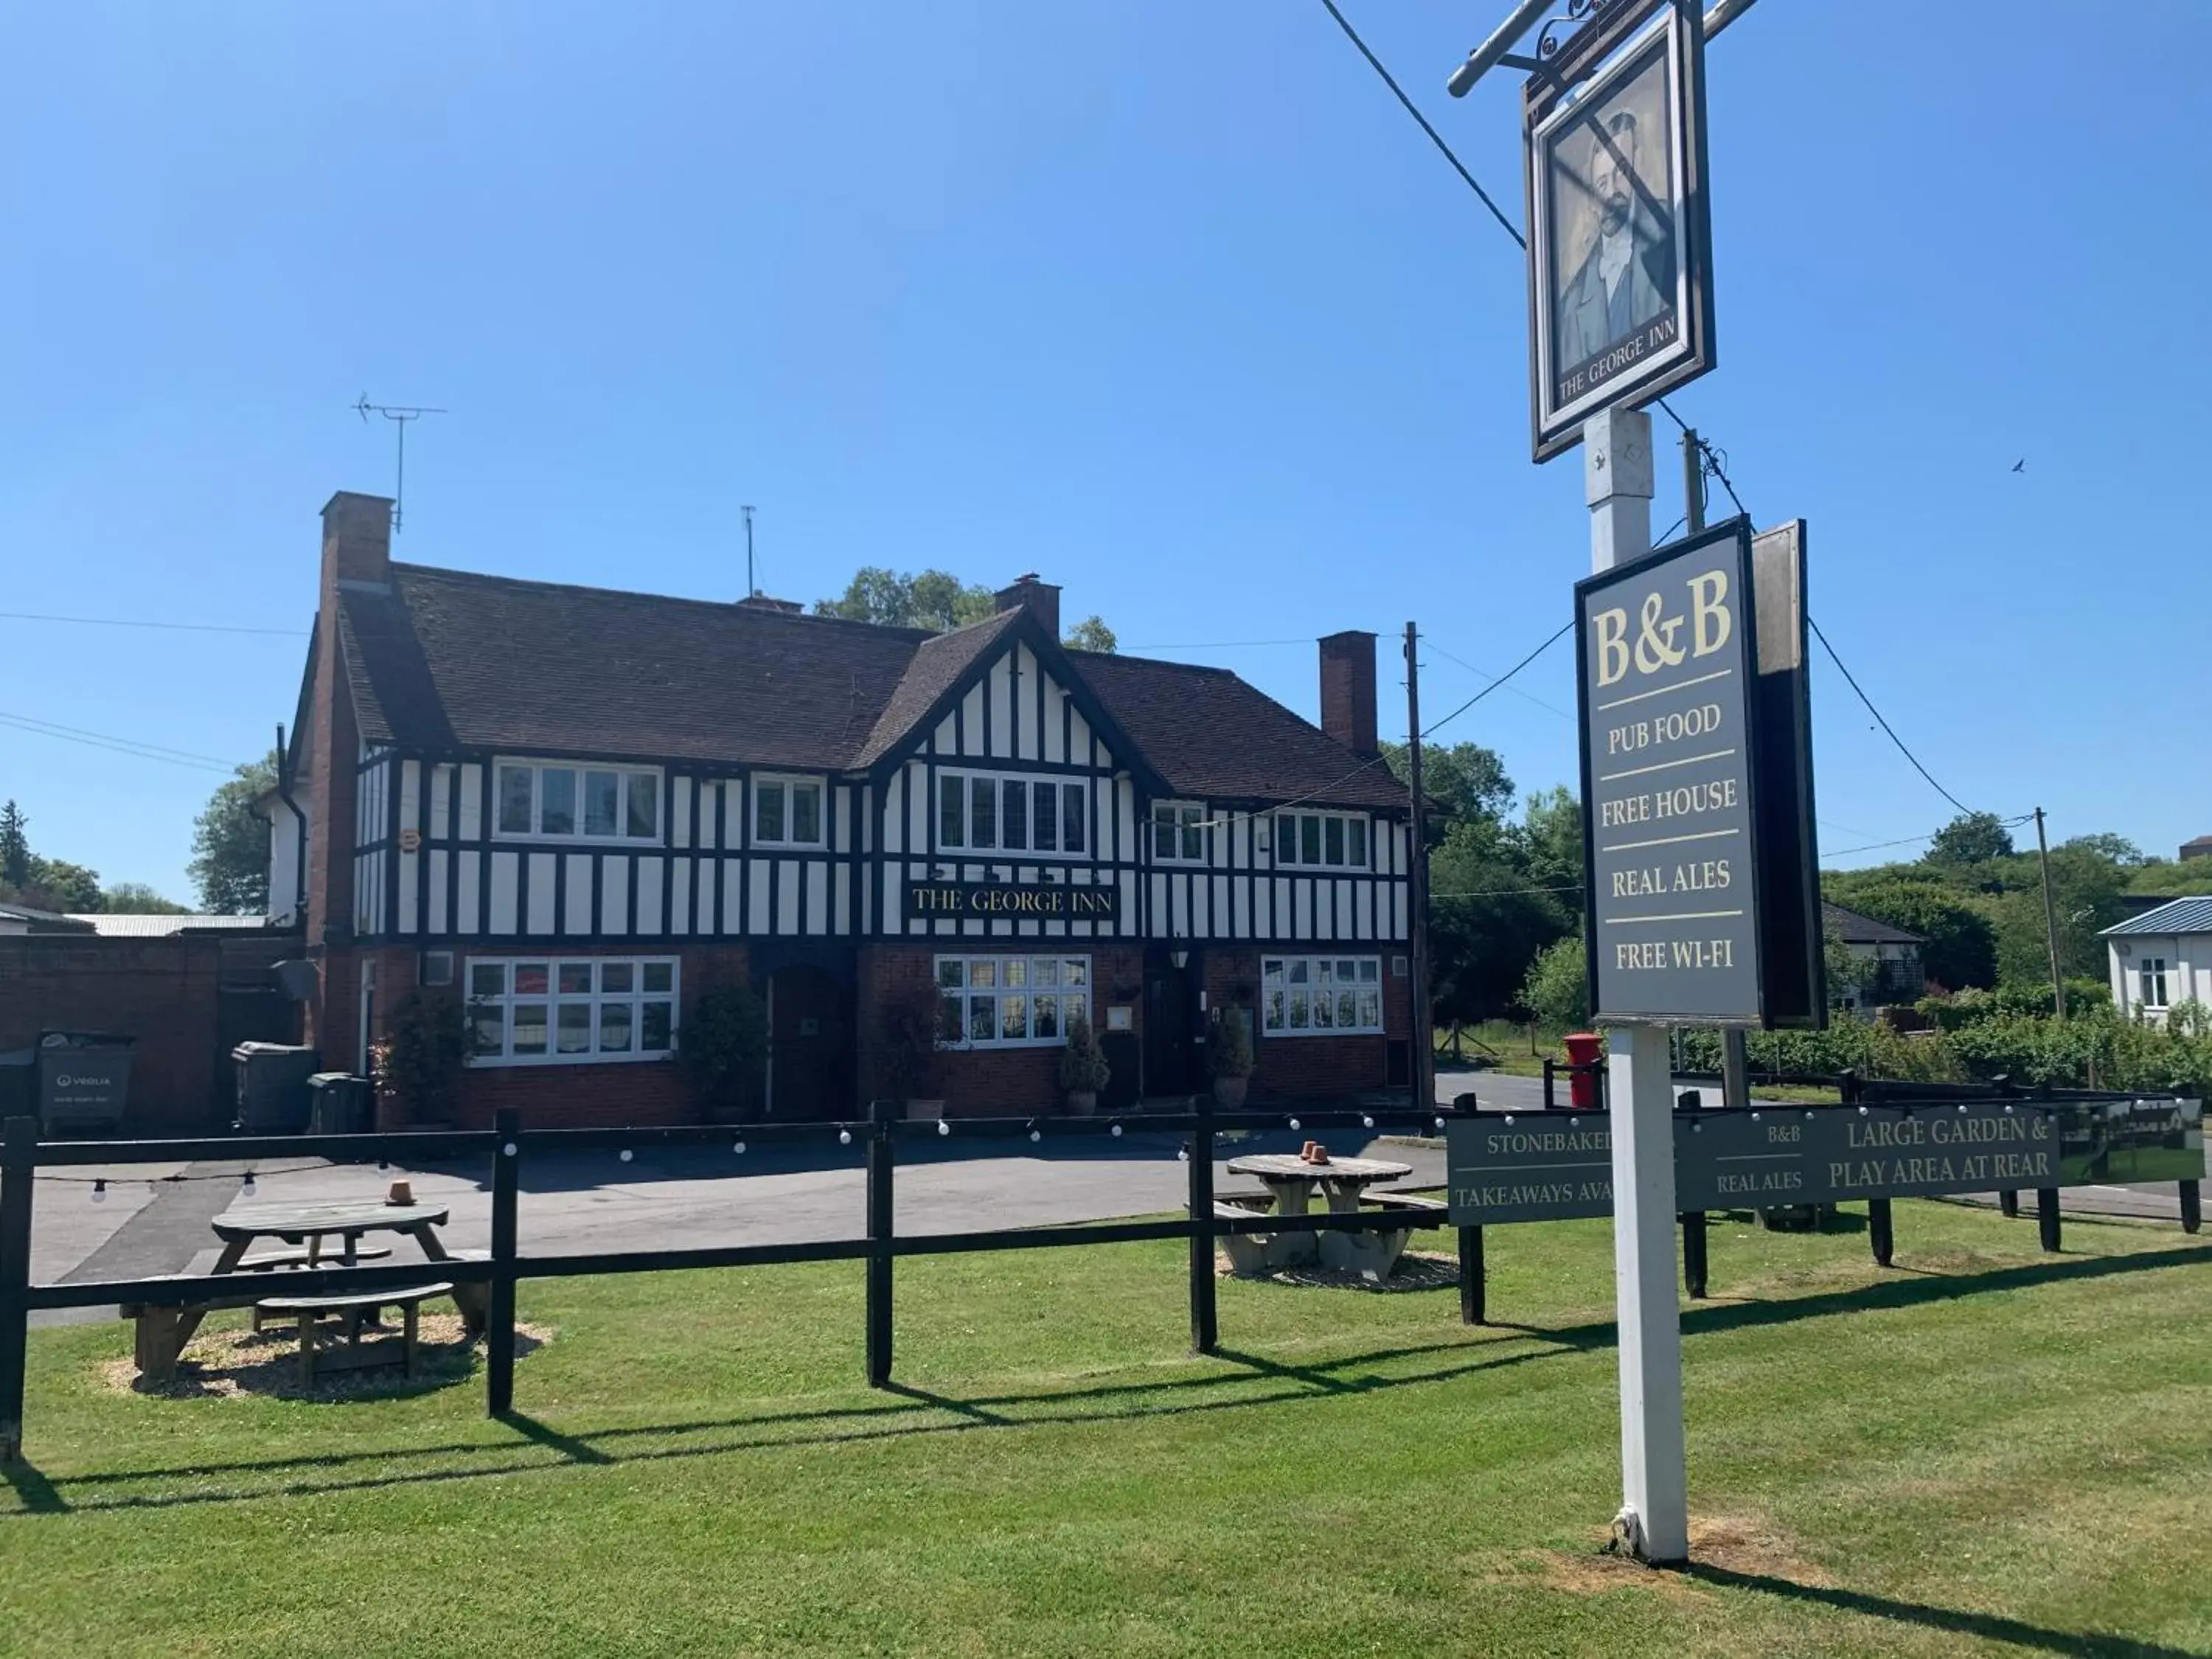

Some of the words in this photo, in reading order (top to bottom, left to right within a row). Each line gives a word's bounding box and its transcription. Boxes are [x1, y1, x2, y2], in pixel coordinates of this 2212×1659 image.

[1559, 375, 1585, 400] THE
[1589, 335, 1644, 383] GEORGE
[1649, 316, 1676, 347] INN
[1593, 570, 1731, 687] B&B
[1609, 722, 1649, 754] PUB
[1655, 703, 1721, 743] FOOD
[1601, 795, 1650, 827] FREE
[1655, 779, 1737, 818] HOUSE
[1612, 867, 1667, 897] REAL
[1672, 859, 1731, 891] ALES
[912, 888, 962, 910] THE
[971, 890, 1063, 911] GEORGE
[1071, 892, 1112, 912] INN
[1616, 943, 1667, 969] FREE
[1672, 939, 1733, 968] WI-FI
[1768, 1124, 1801, 1143] B&B
[1846, 1120, 1926, 1148] LARGE
[1931, 1116, 2026, 1144] GARDEN
[2032, 1116, 2049, 1140] &
[1717, 1172, 1759, 1193] REAL
[1762, 1171, 1803, 1190] ALES
[1829, 1160, 1887, 1188] PLAY
[1892, 1157, 1955, 1184] AREA
[1961, 1155, 1989, 1180] AT
[1994, 1152, 2051, 1178] REAR
[1455, 1183, 1573, 1207] TAKEAWAYS
